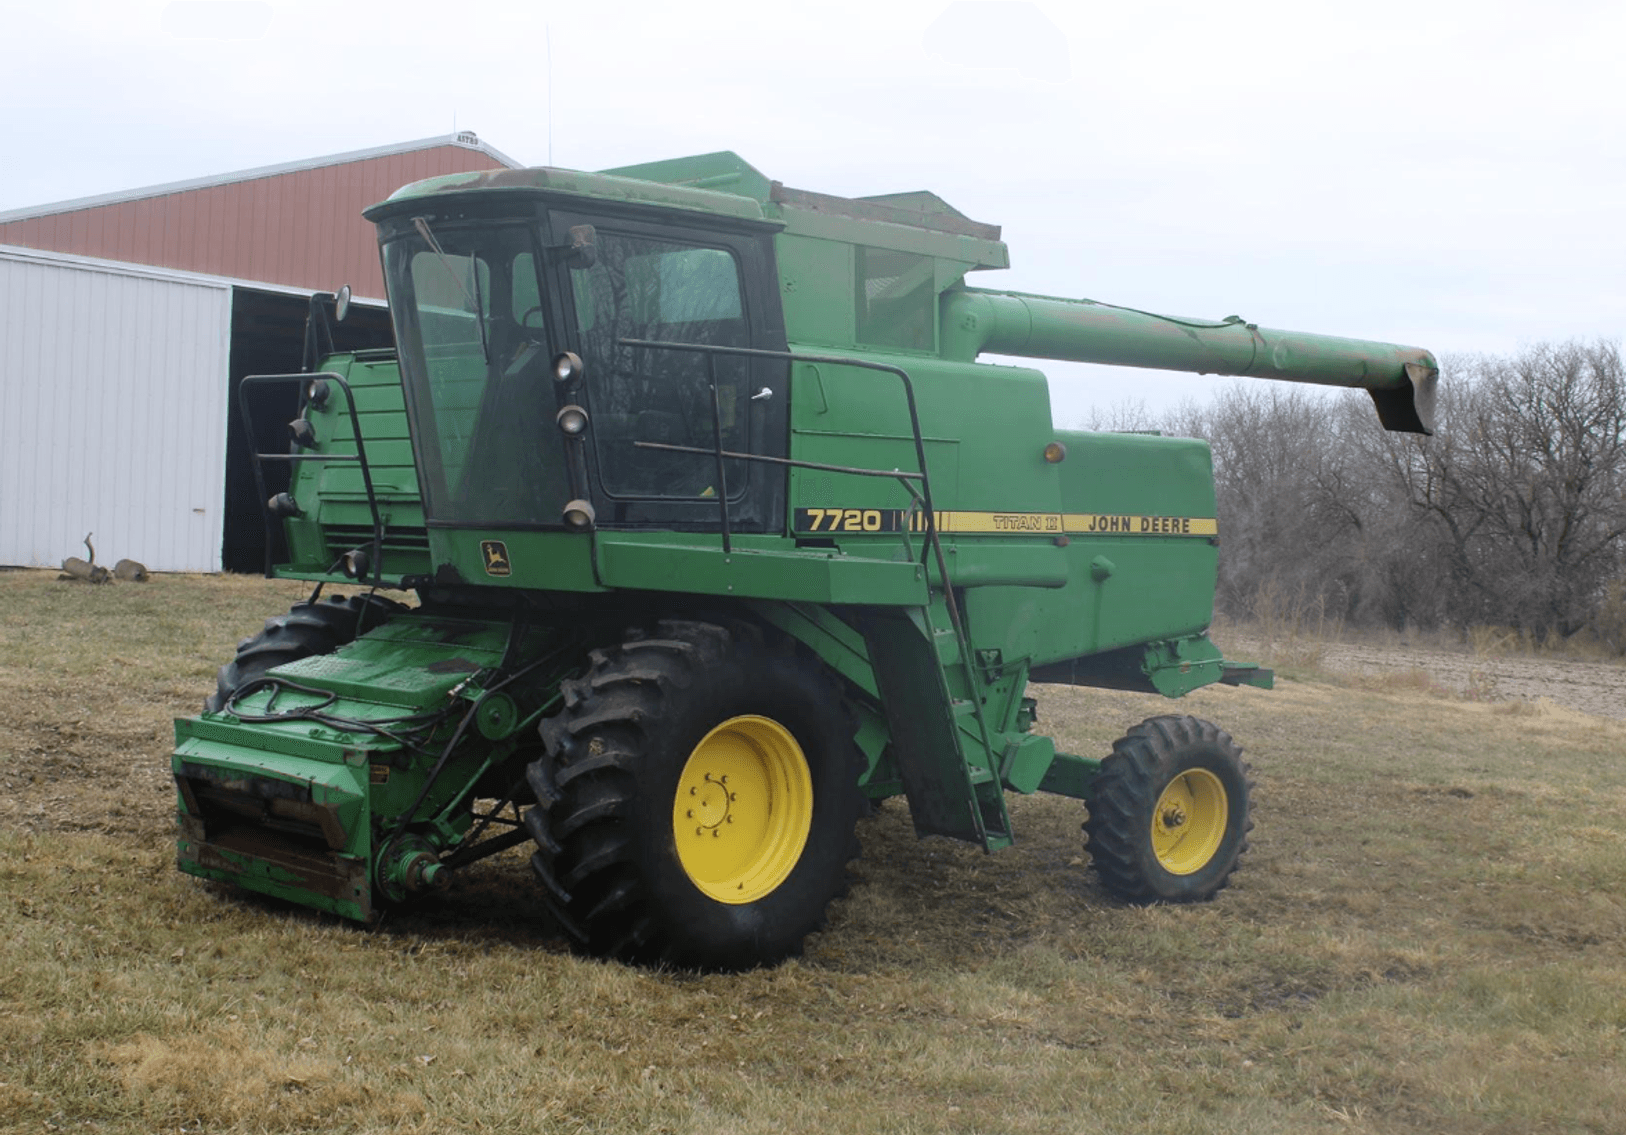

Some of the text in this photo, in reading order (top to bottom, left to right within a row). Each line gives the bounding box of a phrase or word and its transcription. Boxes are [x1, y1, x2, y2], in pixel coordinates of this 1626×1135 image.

[807, 508, 882, 532] 7720
[992, 515, 1058, 531] TITAN II
[1088, 515, 1190, 533] JOHN DEERE
